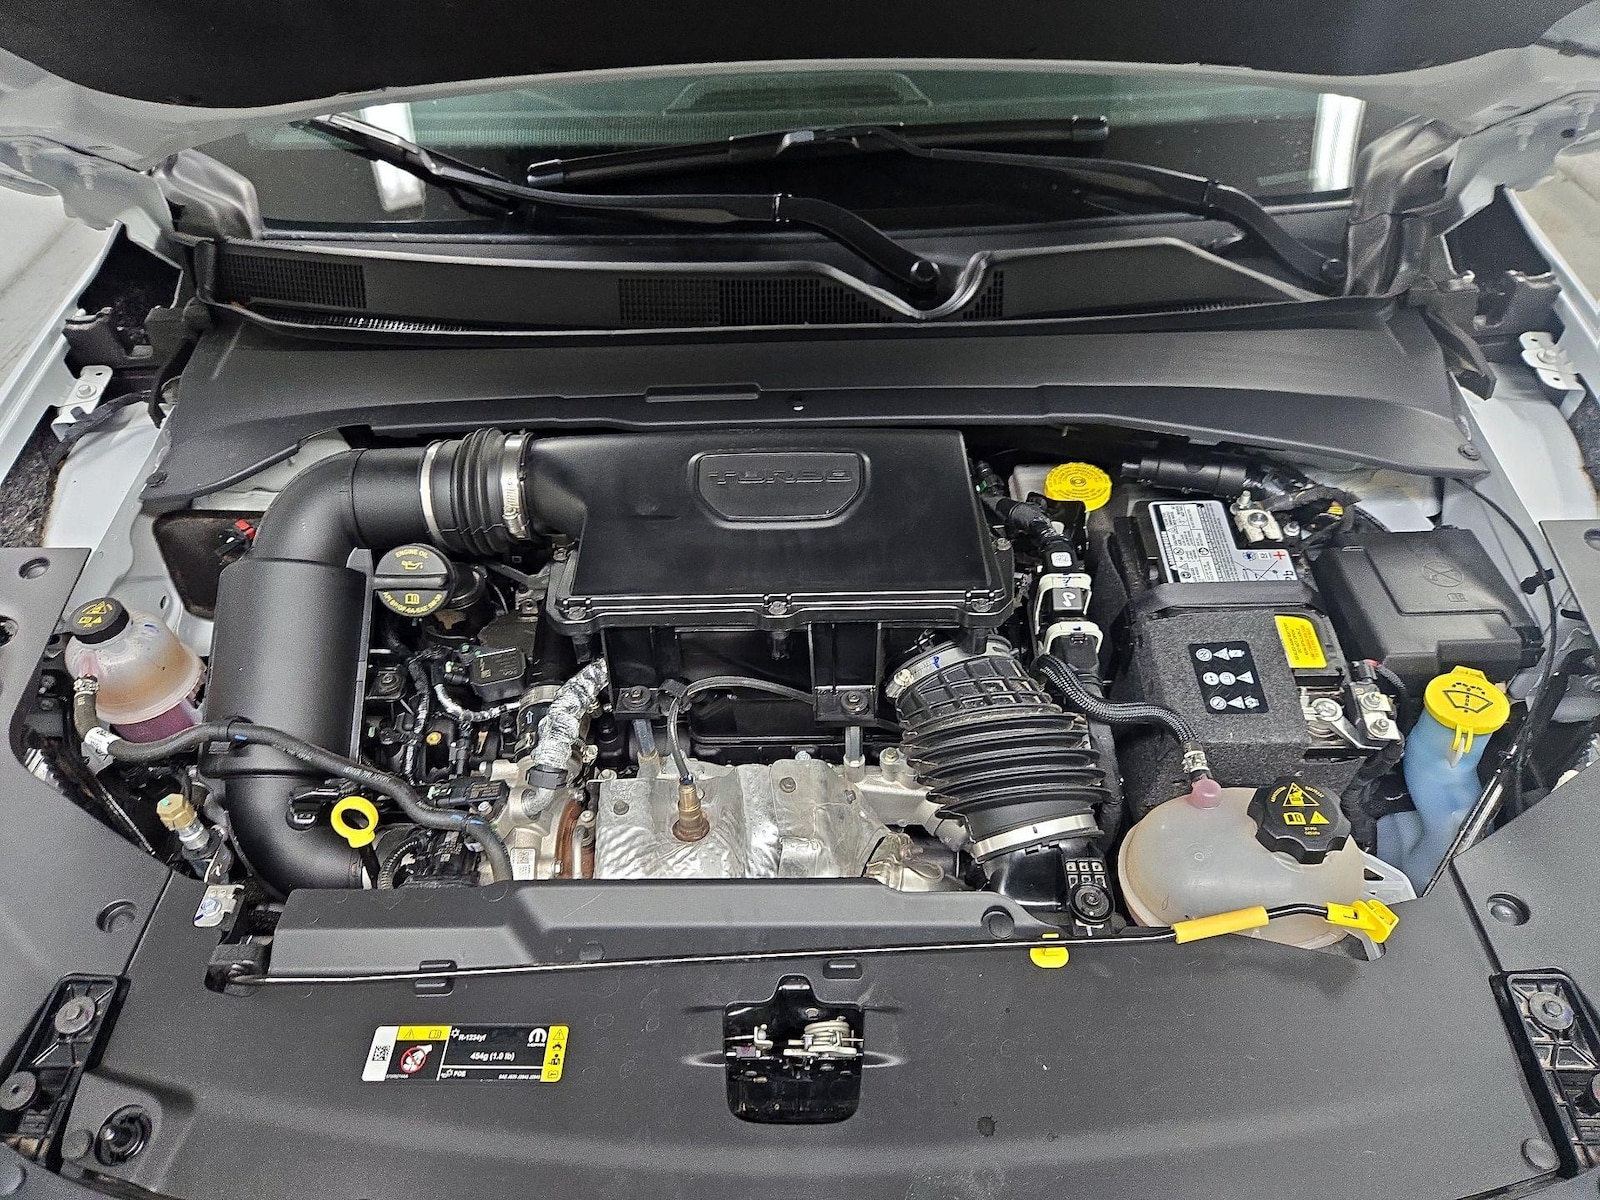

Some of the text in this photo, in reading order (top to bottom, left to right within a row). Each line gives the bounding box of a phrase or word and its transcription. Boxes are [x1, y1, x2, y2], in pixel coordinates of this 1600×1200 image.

[395, 549, 429, 559] ENGINE OIL
[458, 1033, 487, 1042] R-1234yf
[470, 1051, 515, 1061] 454g (1.0 lb)
